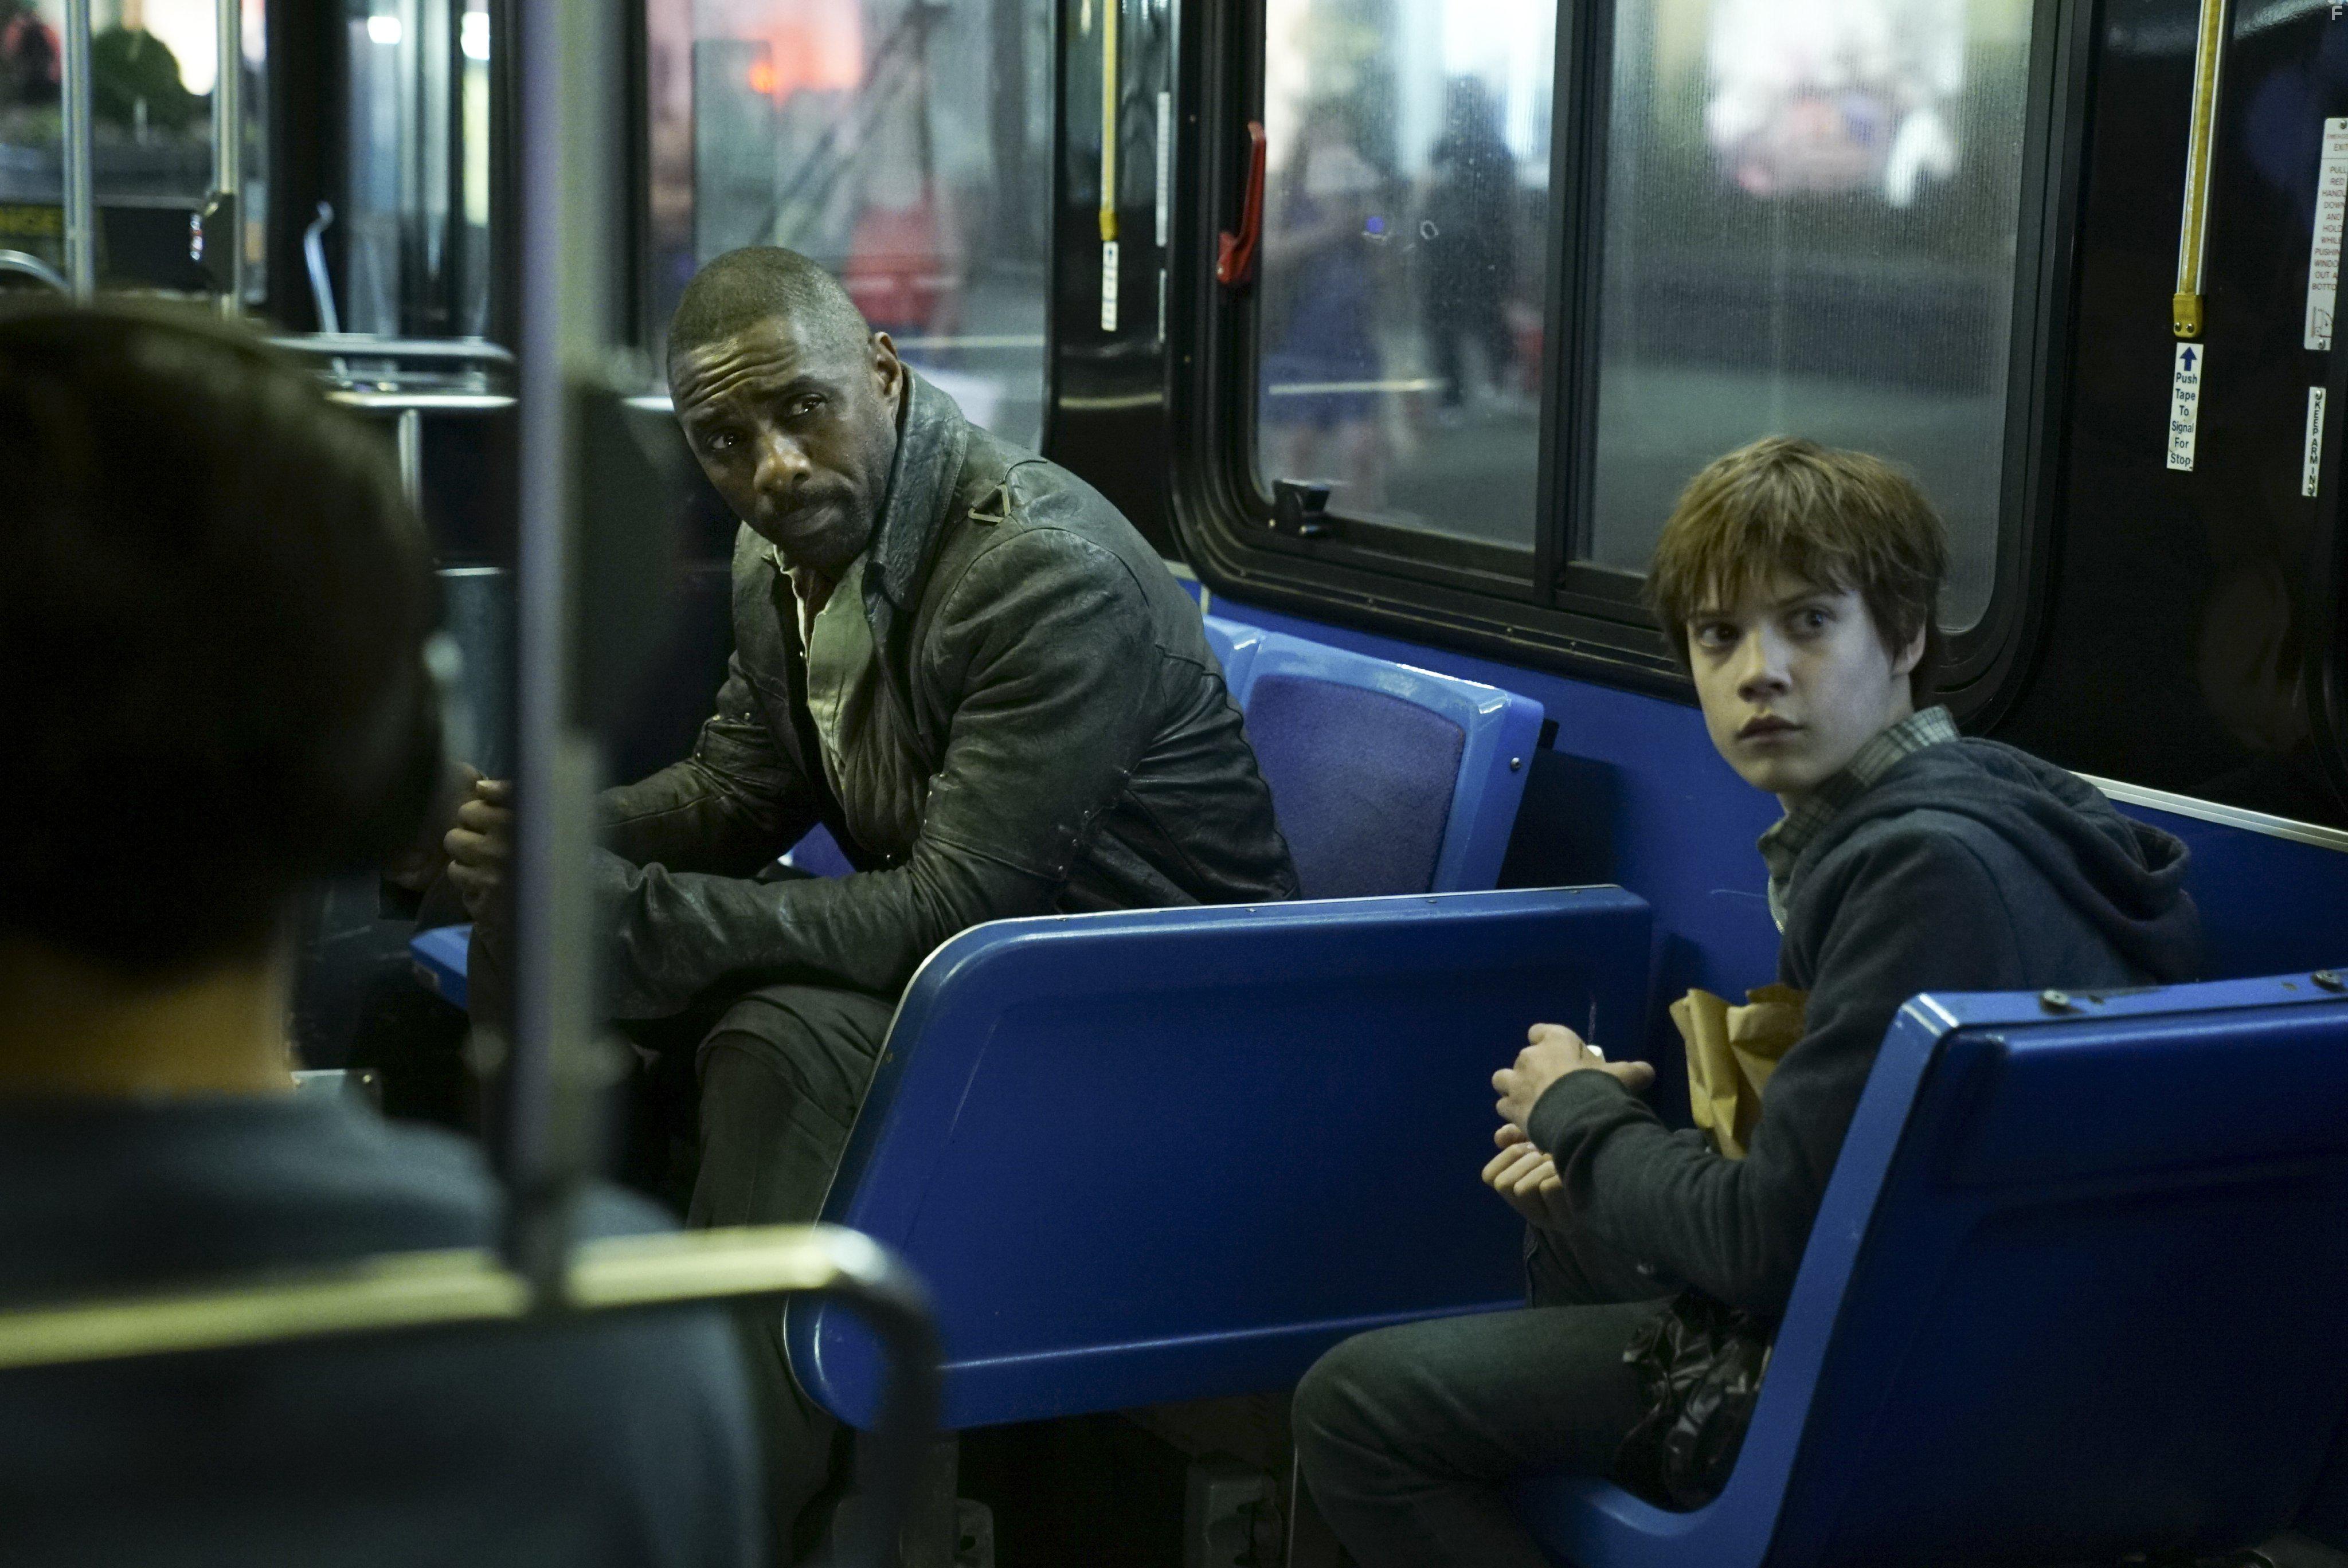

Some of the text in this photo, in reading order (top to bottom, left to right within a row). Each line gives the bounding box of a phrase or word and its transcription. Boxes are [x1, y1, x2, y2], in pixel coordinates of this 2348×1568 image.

[2175, 372, 2197, 384] Push
[2175, 388, 2196, 402] Tape
[2179, 405, 2189, 417] To
[2312, 402, 2320, 436] KEEP
[2172, 420, 2194, 434] Signal
[2175, 437, 2189, 449] For
[2309, 438, 2318, 464] ARM
[2170, 452, 2190, 467] Stop
